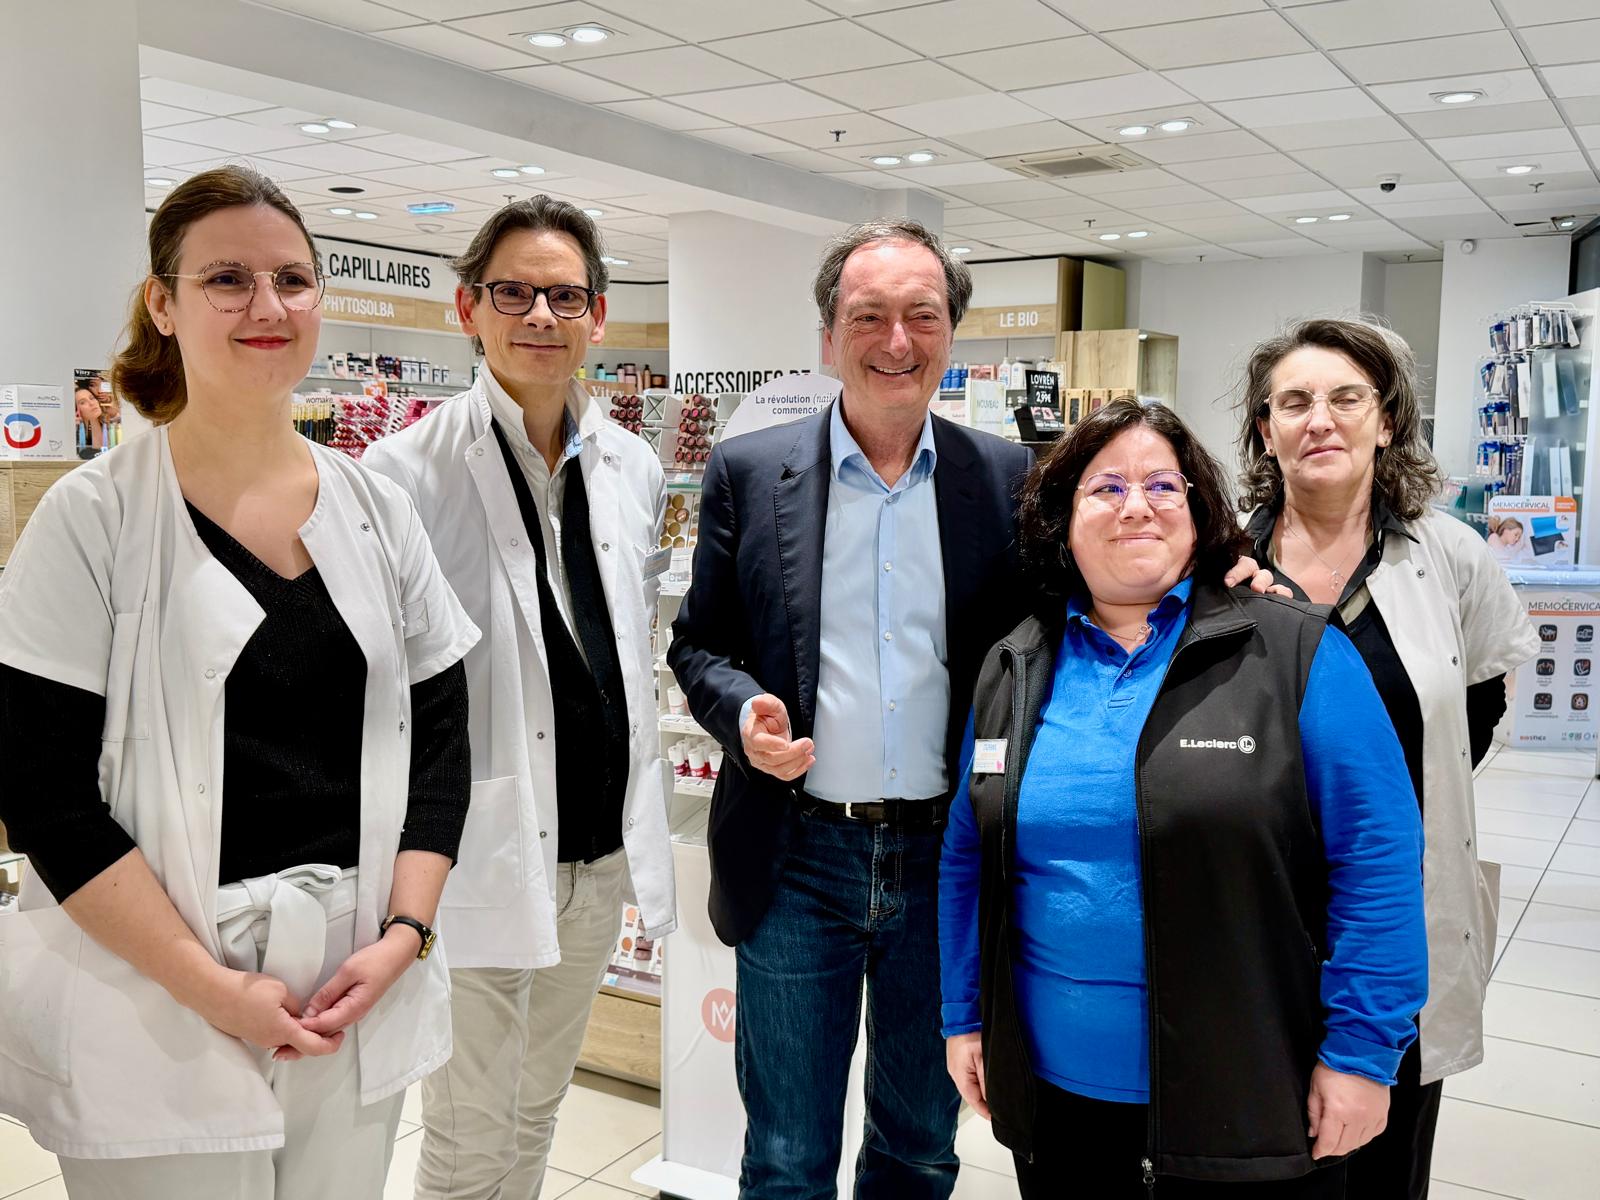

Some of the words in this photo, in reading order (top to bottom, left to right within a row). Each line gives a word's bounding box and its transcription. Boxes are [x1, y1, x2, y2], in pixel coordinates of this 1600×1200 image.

[329, 253, 431, 288] CAPILLAIRES
[324, 296, 395, 318] PHYTOSOLBA
[999, 312, 1014, 328] LE
[1018, 311, 1039, 327] BIO
[755, 396, 766, 404] La
[768, 395, 811, 404] révolution
[772, 406, 818, 415] commence
[1179, 738, 1237, 749] E.Leclerc
